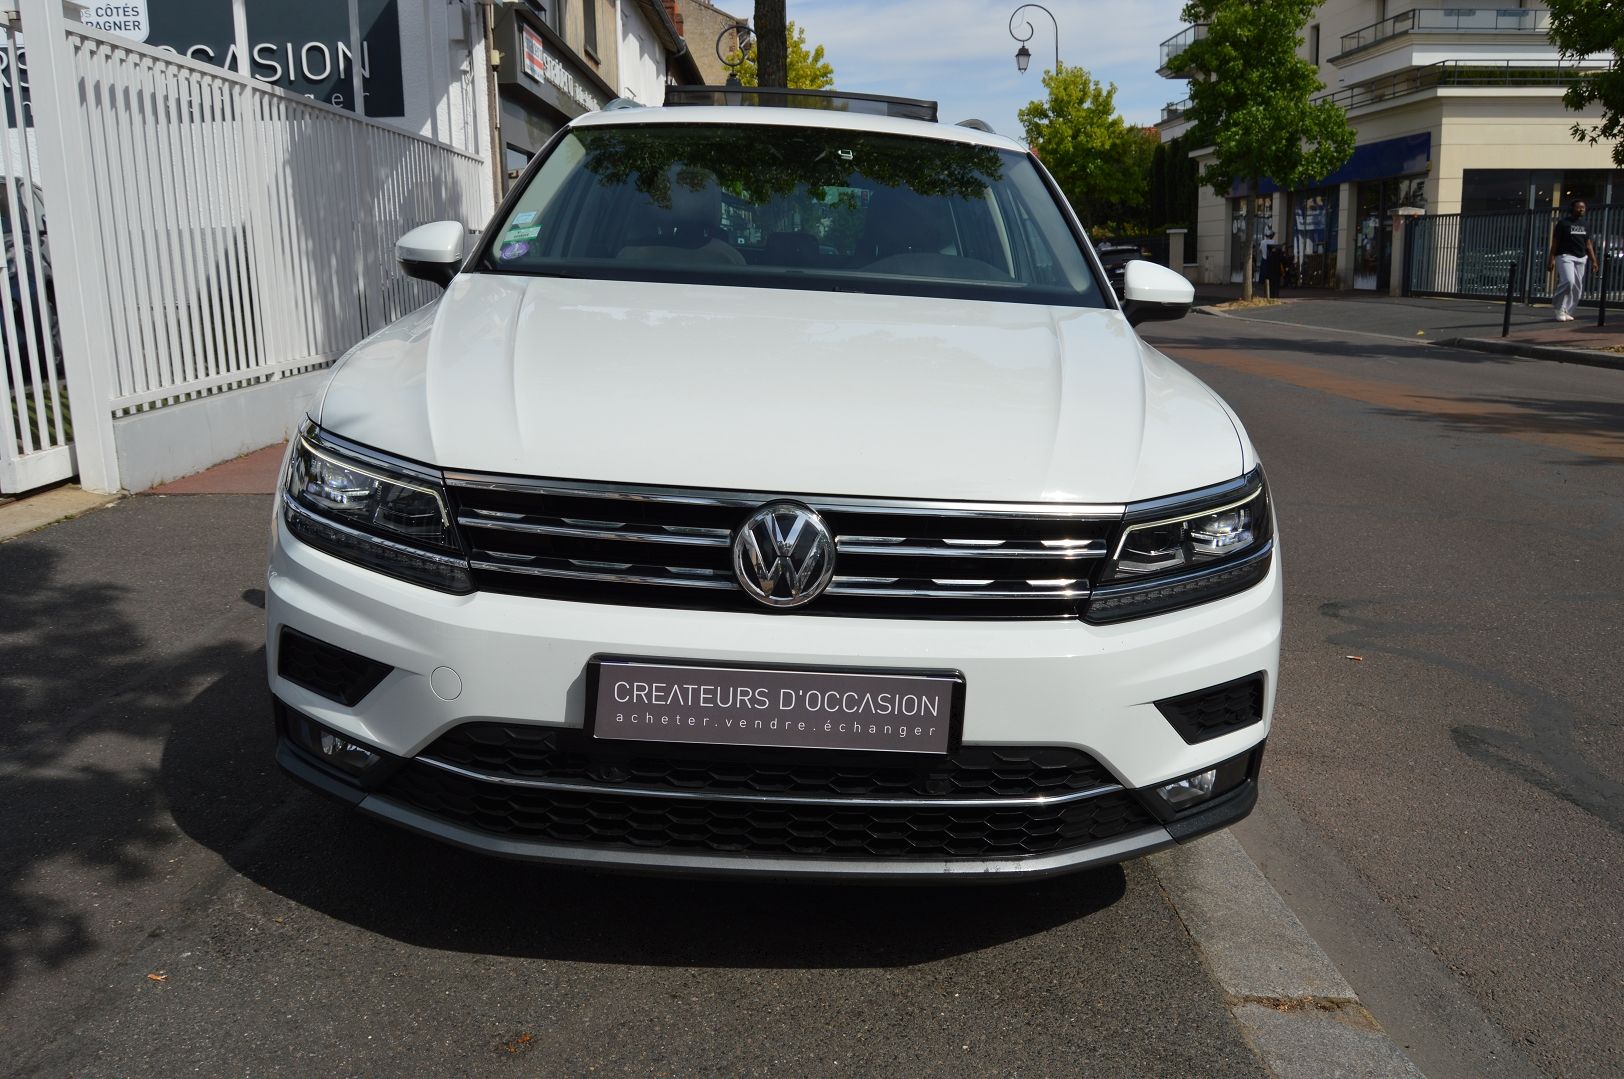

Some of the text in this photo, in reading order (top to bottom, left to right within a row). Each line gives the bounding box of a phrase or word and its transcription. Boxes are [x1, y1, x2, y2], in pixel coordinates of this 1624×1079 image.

[95, 3, 140, 18] CÔTÉS
[613, 681, 939, 717] CREATEURS D'OCCASION
